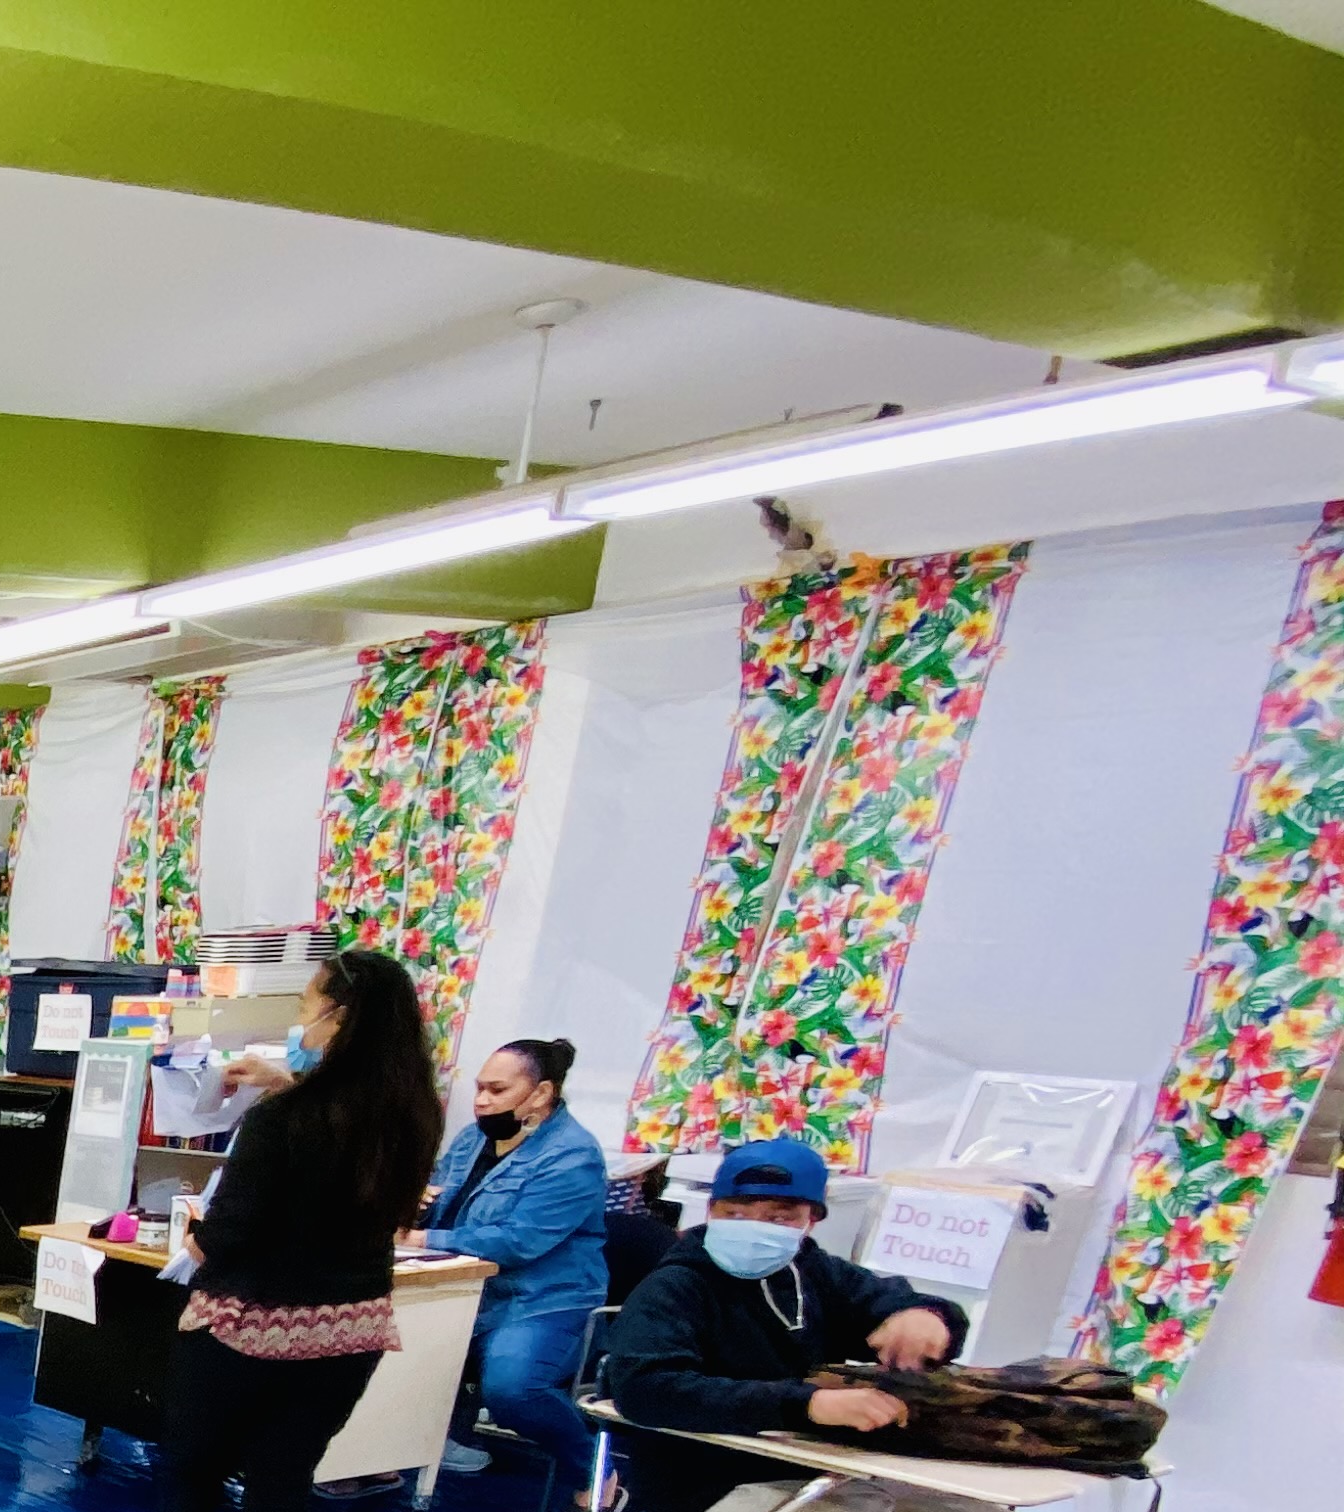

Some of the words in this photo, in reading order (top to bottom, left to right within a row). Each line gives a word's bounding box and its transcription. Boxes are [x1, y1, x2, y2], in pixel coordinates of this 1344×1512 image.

[43, 1005, 60, 1019] Do
[63, 1007, 85, 1019] not
[41, 1025, 80, 1039] Touch
[891, 1203, 931, 1228] Do
[937, 1215, 990, 1238] not
[43, 1251, 67, 1272] Do
[883, 1234, 972, 1269] Touch
[42, 1278, 87, 1306] Touch
